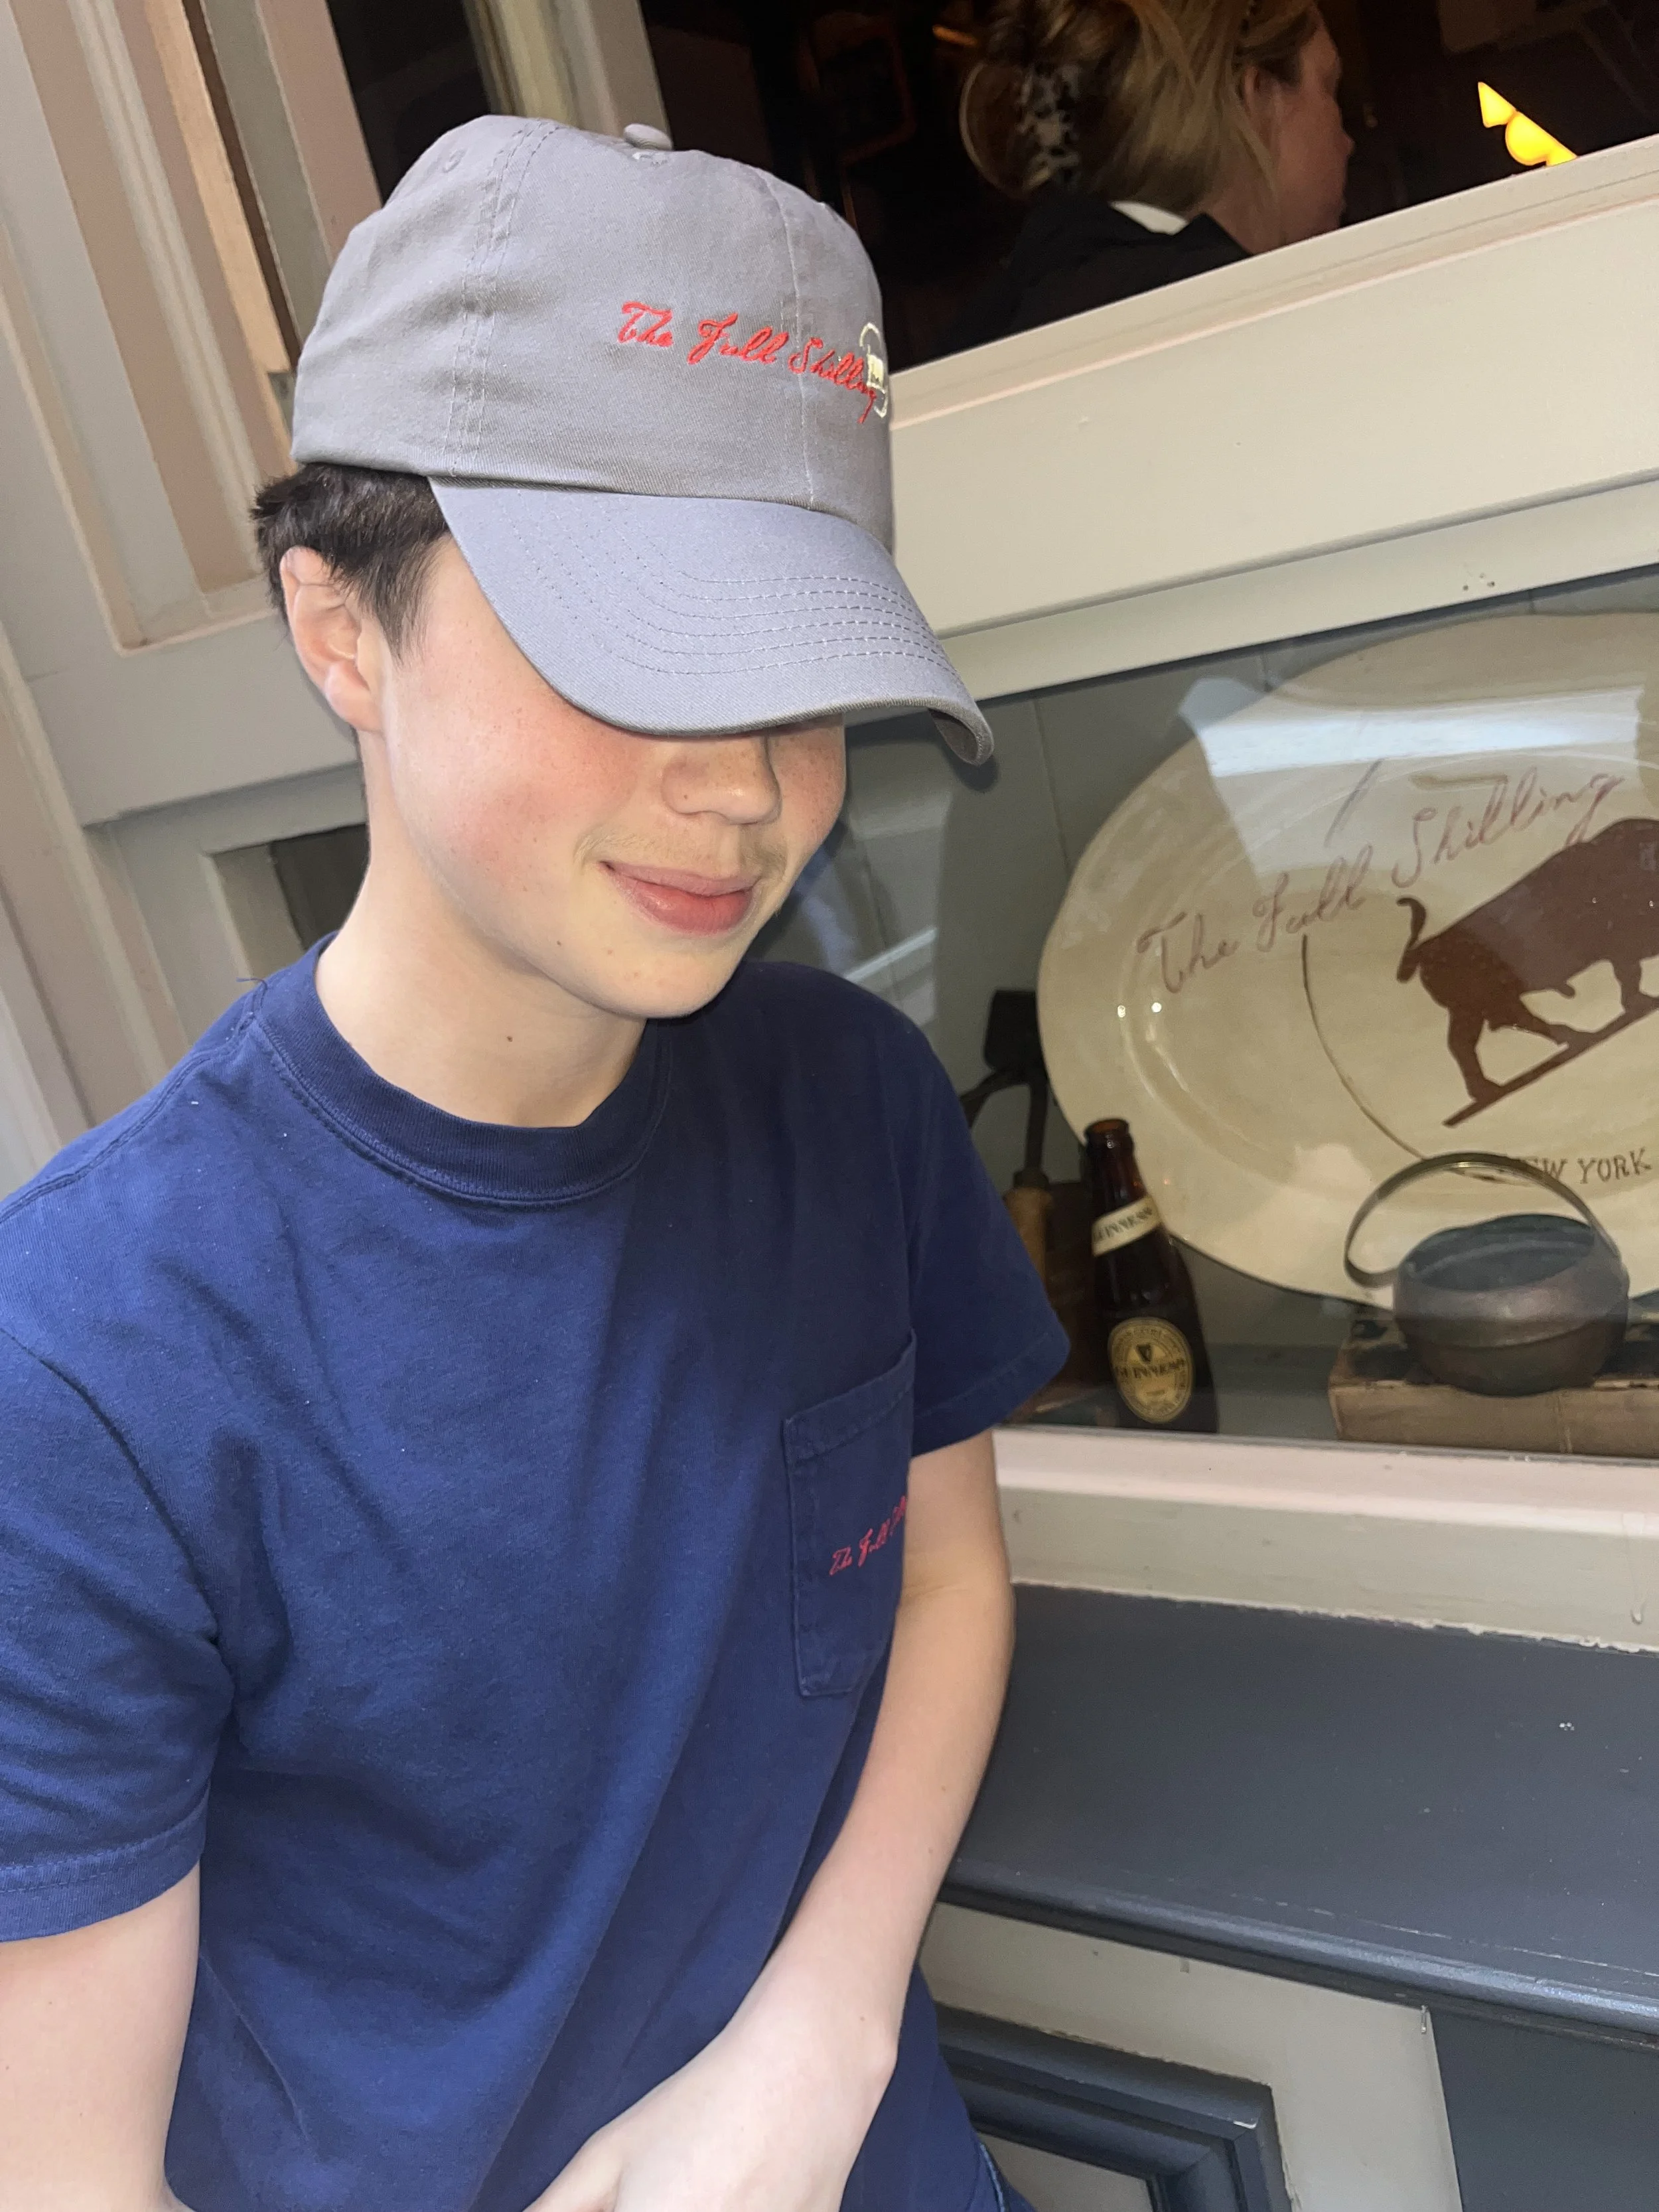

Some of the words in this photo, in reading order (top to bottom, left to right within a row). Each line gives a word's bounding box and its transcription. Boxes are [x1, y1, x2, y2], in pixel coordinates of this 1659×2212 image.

[617, 301, 674, 348] The
[686, 311, 790, 365] Full
[1136, 911, 1240, 995] The
[1252, 844, 1374, 953] Full
[1391, 766, 1626, 888] Shilling
[1577, 1145, 1652, 1185] YORK
[829, 1545, 853, 1577] The
